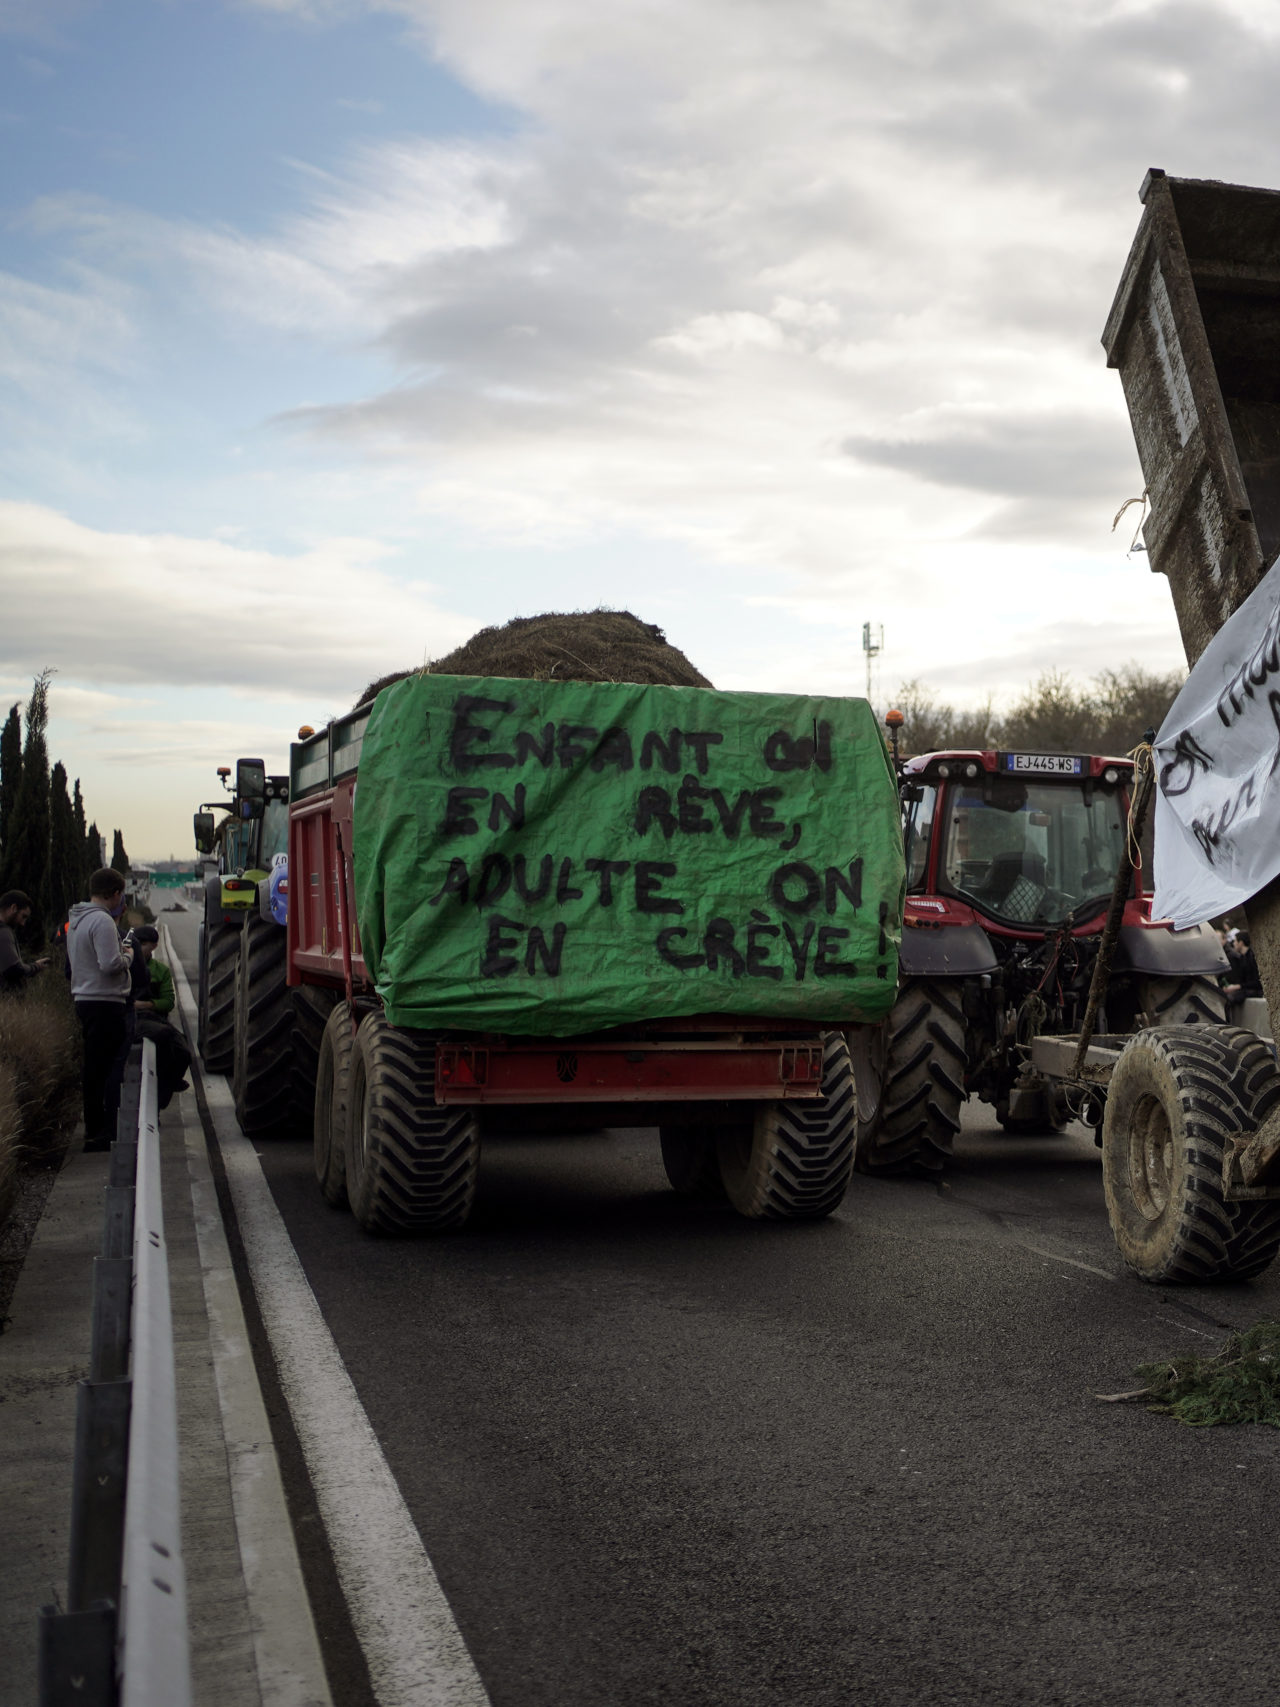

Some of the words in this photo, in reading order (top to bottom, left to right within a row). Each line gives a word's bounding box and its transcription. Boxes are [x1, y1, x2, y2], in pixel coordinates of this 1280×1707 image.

[450, 695, 723, 775] ENFANT
[443, 782, 527, 836] EN
[633, 774, 801, 851] RÊVE,
[430, 853, 684, 914] ADULTE
[769, 856, 864, 914] ON
[480, 914, 567, 978] EN
